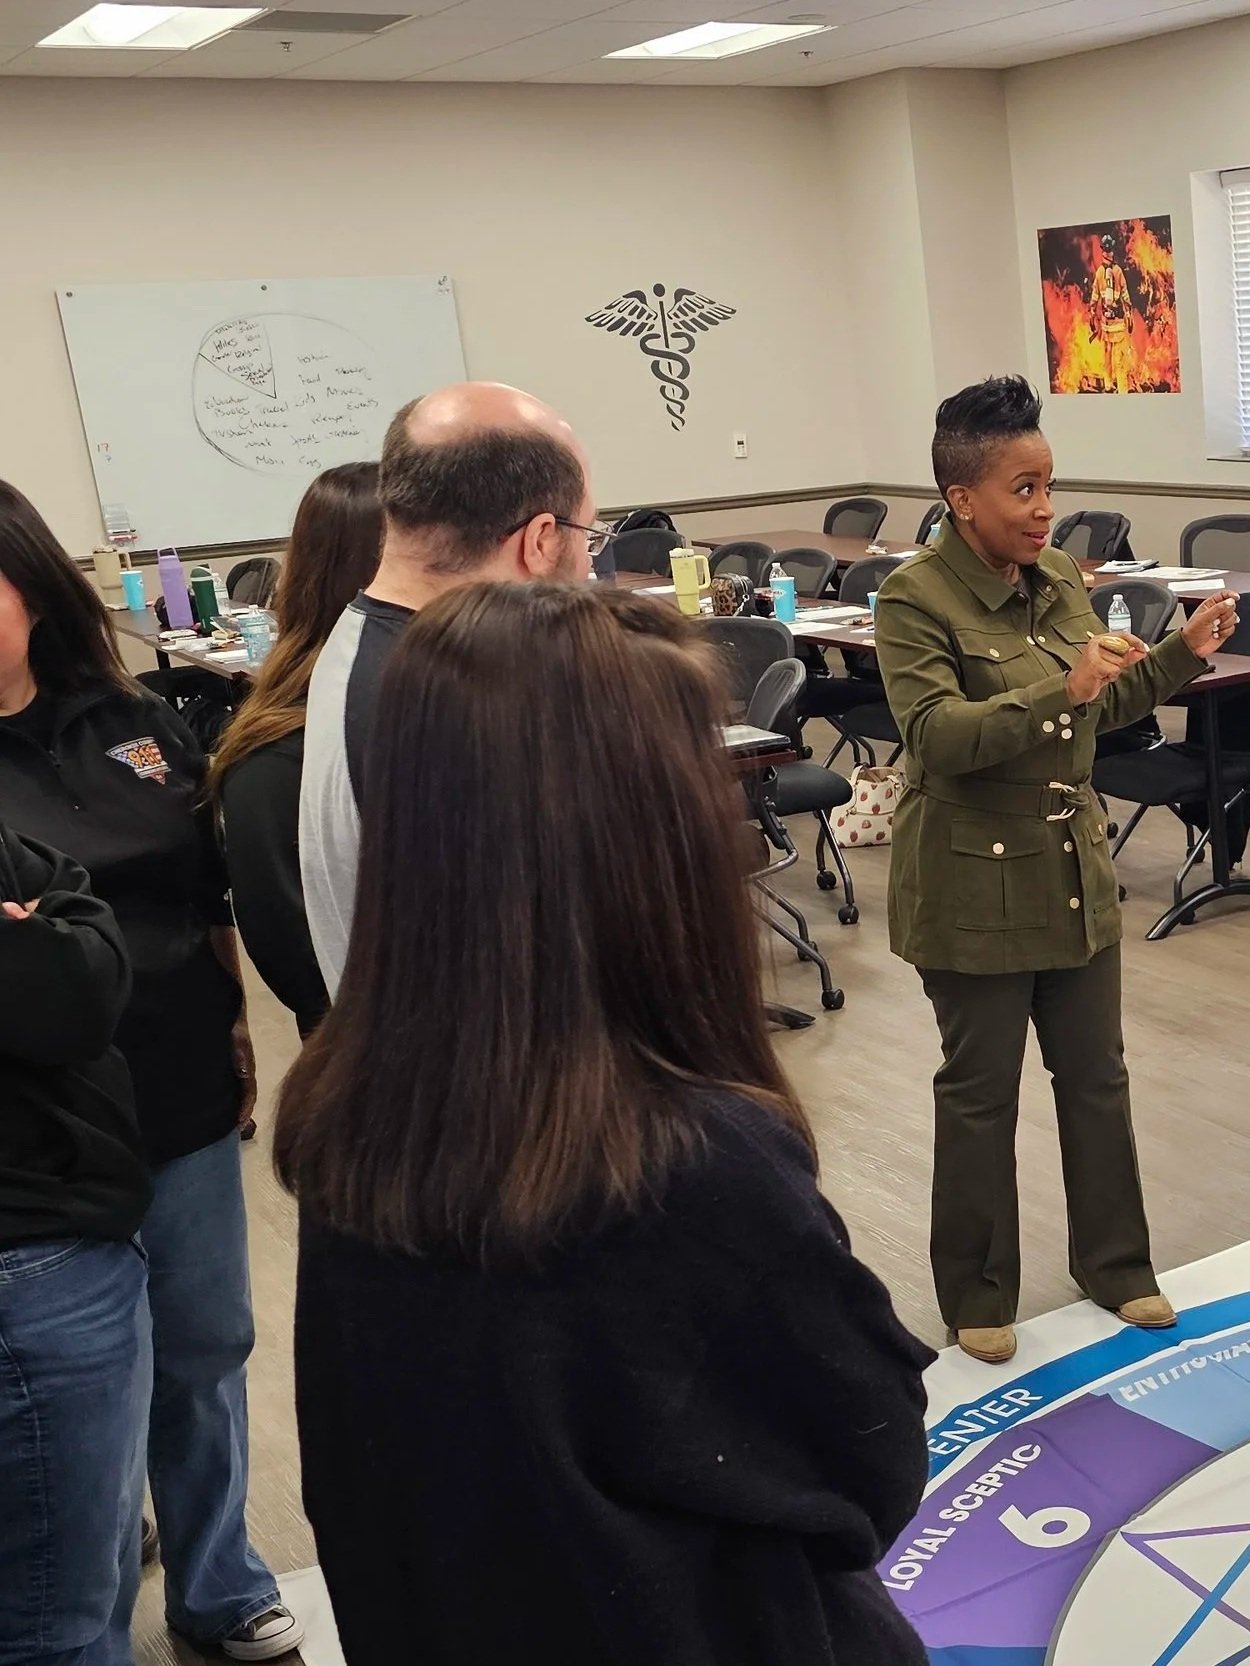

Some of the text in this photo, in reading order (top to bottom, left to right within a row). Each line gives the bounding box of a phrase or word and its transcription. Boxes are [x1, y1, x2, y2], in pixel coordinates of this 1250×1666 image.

[927, 1388, 1044, 1455] ENTER
[882, 1443, 1042, 1591] LOYAL SCEPTIC
[998, 1504, 1092, 1549] 6
